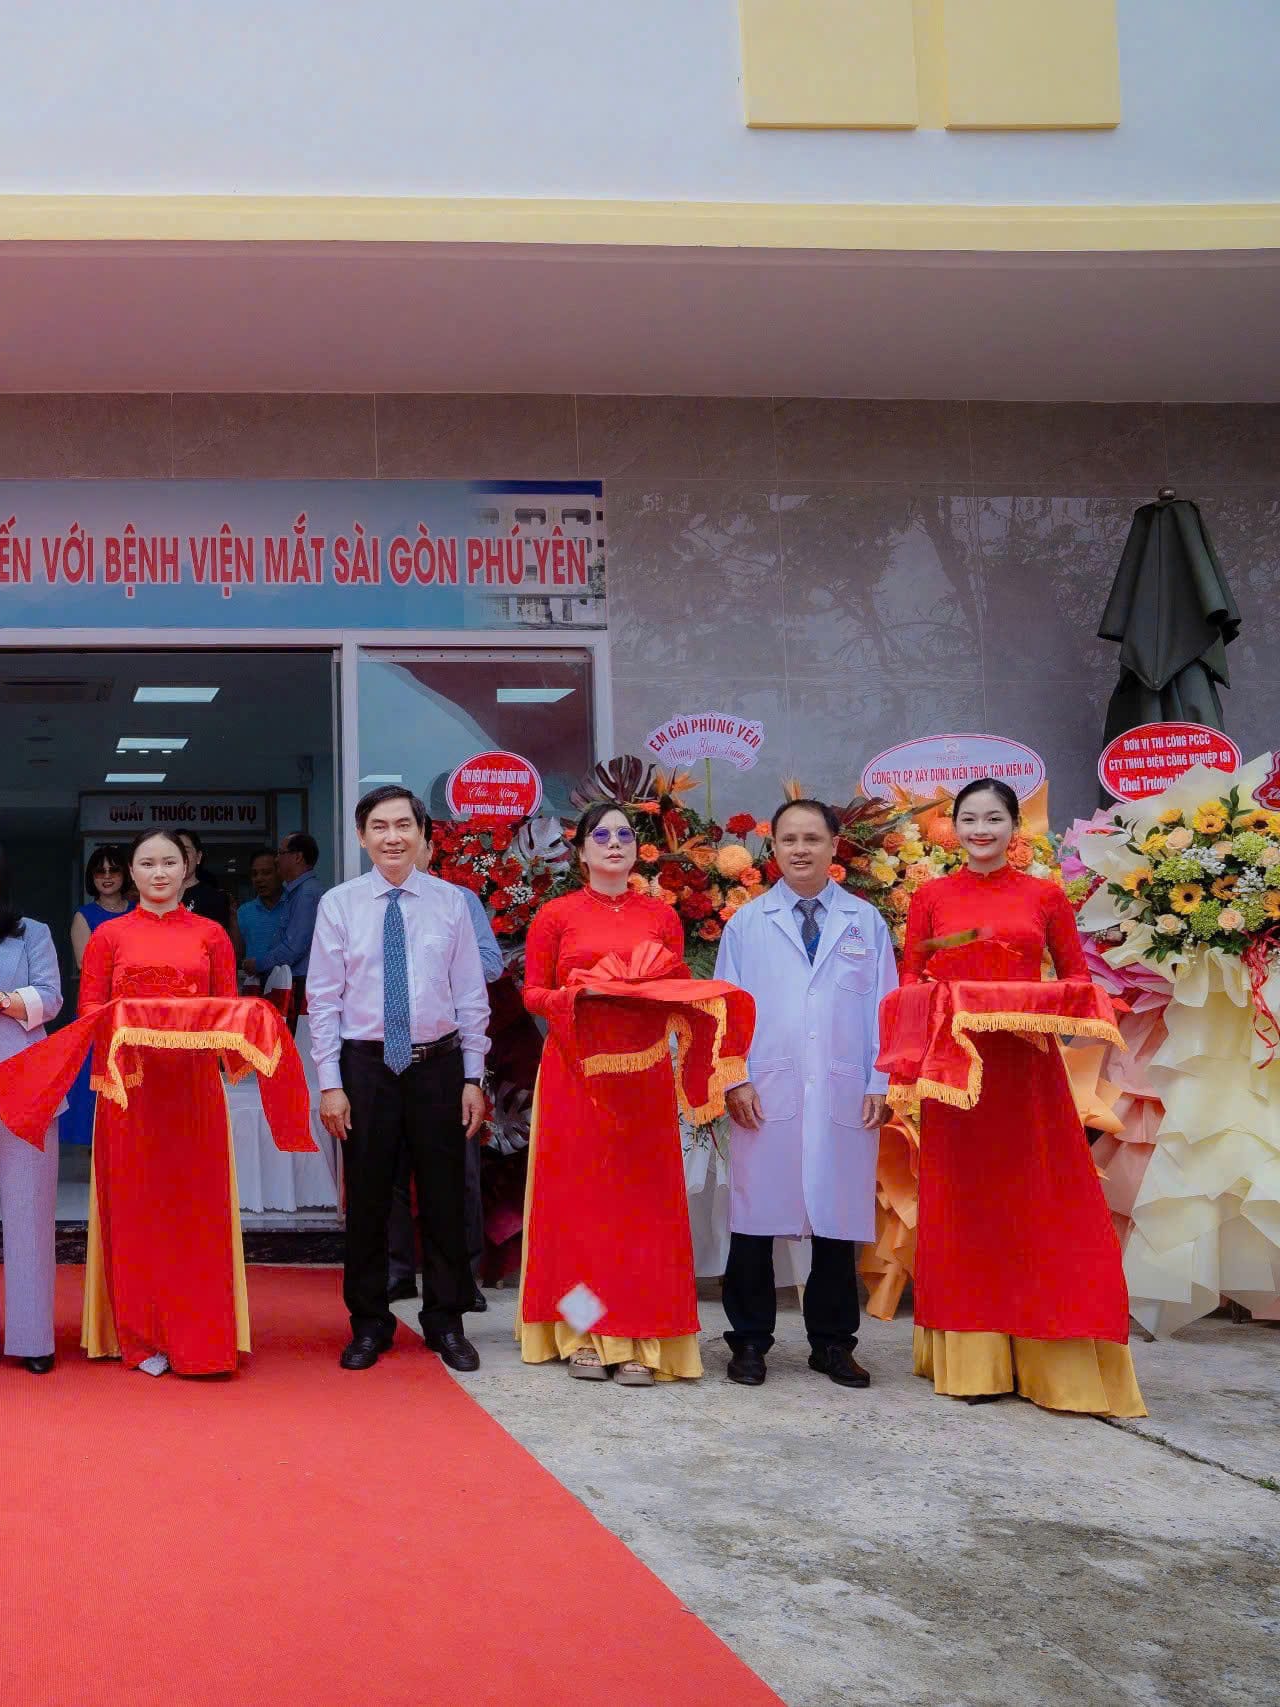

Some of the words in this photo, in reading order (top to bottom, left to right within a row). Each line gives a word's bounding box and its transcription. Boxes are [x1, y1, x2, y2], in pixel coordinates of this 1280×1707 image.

[41, 522, 94, 583] VỚI
[105, 523, 179, 597] BỆNH
[189, 523, 254, 597] VIỆN
[265, 512, 325, 583] MẮT
[334, 523, 380, 584] SÀI
[389, 523, 457, 585] GÒN
[468, 523, 524, 585] PHÚ
[532, 525, 586, 585] YÊN
[649, 731, 669, 752] EM
[668, 719, 689, 739] GÁI
[691, 713, 735, 735] PHÙNG
[1124, 739, 1140, 751] ĐƠN
[1141, 738, 1149, 752] VỊ
[1151, 737, 1164, 749] THI
[1166, 734, 1187, 748] CÔNG
[1189, 734, 1210, 746] PCCC
[1109, 759, 1122, 771] CTY
[1125, 757, 1145, 769] TNHH
[1146, 754, 1164, 769] ĐIỆN
[1166, 753, 1187, 767] CÔNG
[1189, 751, 1218, 767] NGHIỆP
[871, 768, 891, 784] CÔNG
[893, 771, 901, 783] TY
[903, 770, 913, 782] CP
[1024, 763, 1034, 775] AN
[1119, 776, 1140, 792] Khai
[150, 801, 197, 822] THUỐC
[200, 805, 233, 823] DỊCH
[237, 806, 256, 824] VỤ
